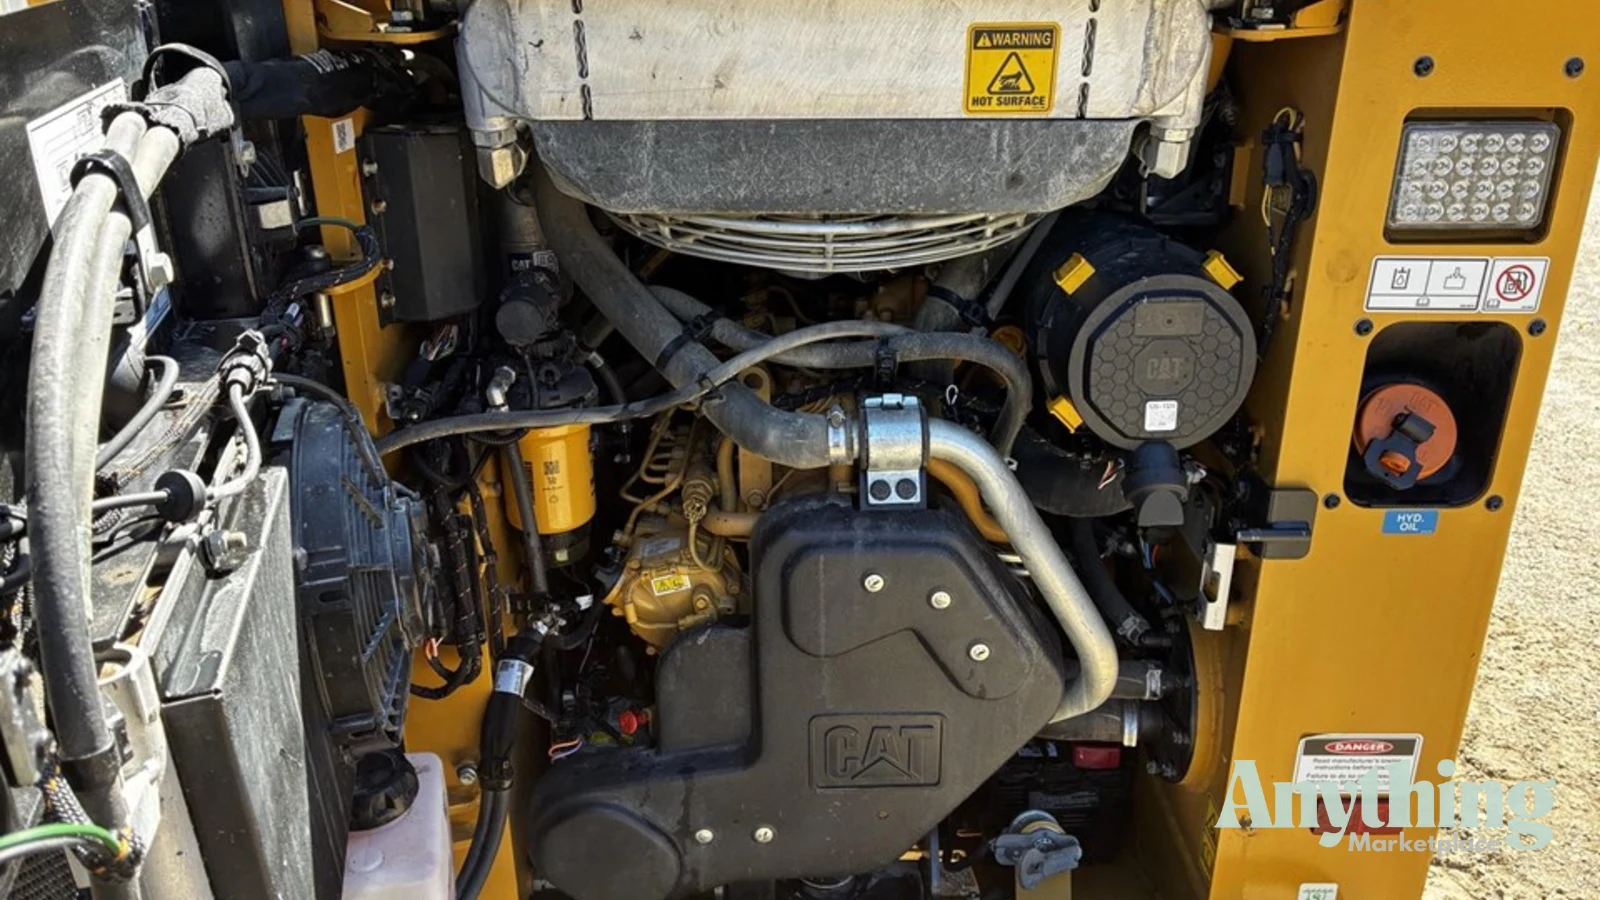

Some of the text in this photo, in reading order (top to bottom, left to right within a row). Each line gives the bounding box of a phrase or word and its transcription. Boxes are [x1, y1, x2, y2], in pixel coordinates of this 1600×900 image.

[992, 32, 1051, 46] WARNING
[972, 96, 1046, 106] HOT SURFACE
[511, 259, 531, 270] CAT
[1146, 358, 1184, 379] CAT
[1396, 513, 1424, 523] HYD.
[1399, 522, 1419, 531] OIL
[1335, 743, 1384, 751] DANGER
[825, 724, 934, 783] CAT
